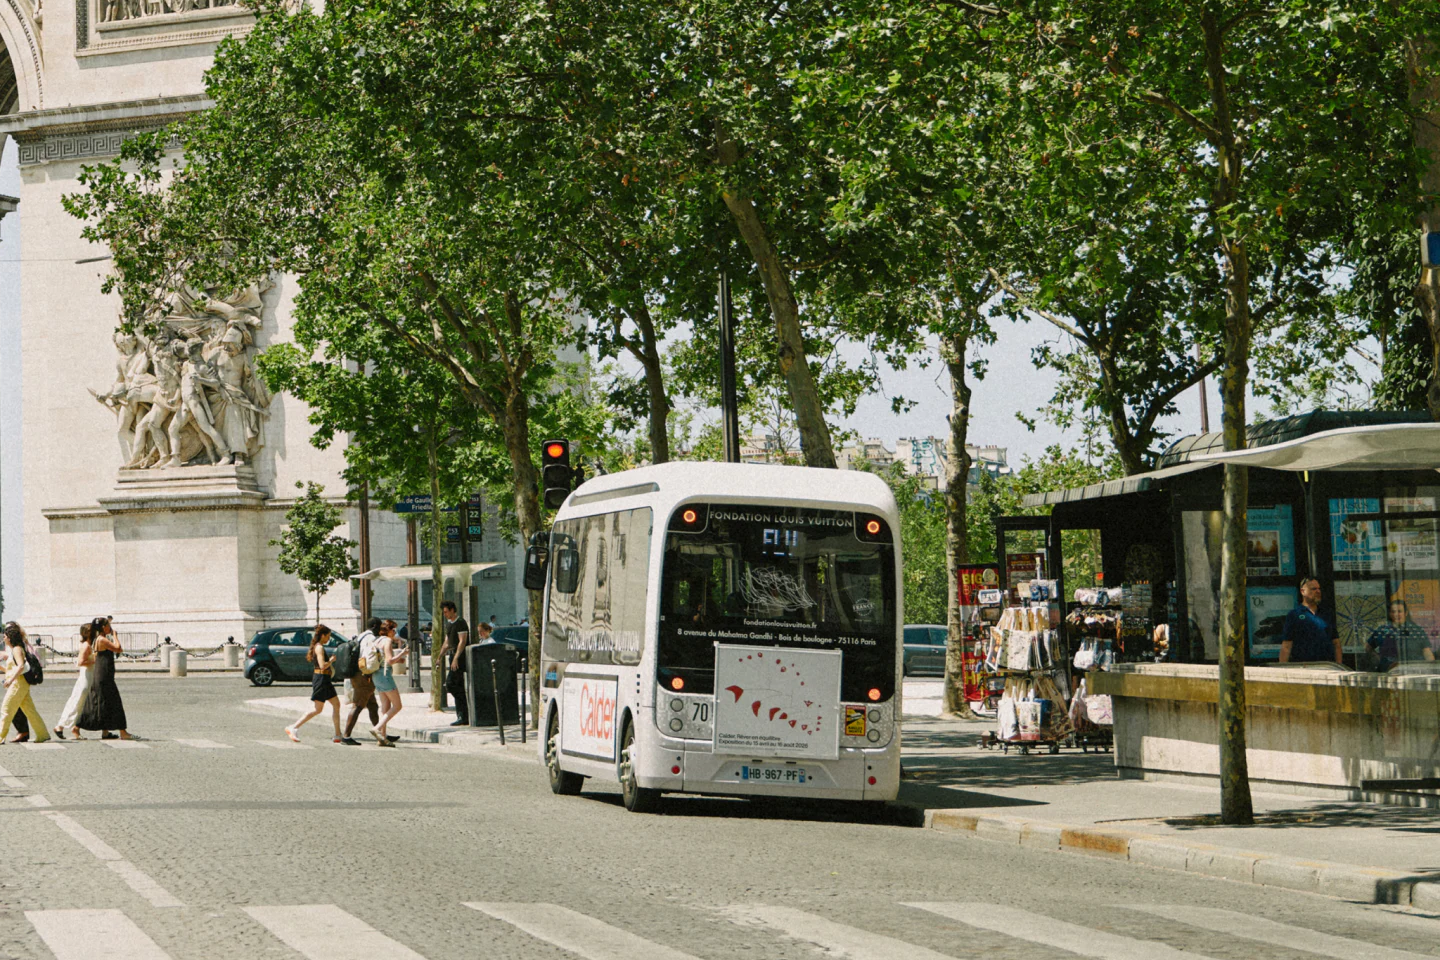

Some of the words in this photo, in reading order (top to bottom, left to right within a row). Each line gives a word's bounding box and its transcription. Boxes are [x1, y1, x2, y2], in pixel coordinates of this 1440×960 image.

[709, 511, 771, 523] FONDATION
[774, 514, 804, 525] LOUIS
[808, 516, 853, 528] VUITTON
[743, 618, 818, 630] fondationlouisvuitton.fr
[708, 630, 717, 638] du
[717, 630, 748, 639] Mahatma
[749, 632, 773, 640] Gandhi
[793, 634, 802, 642] de
[803, 635, 833, 644] boulogne
[838, 636, 859, 645] 75116
[861, 638, 877, 646] Paris
[580, 682, 615, 740] Calder
[692, 702, 708, 722] 70
